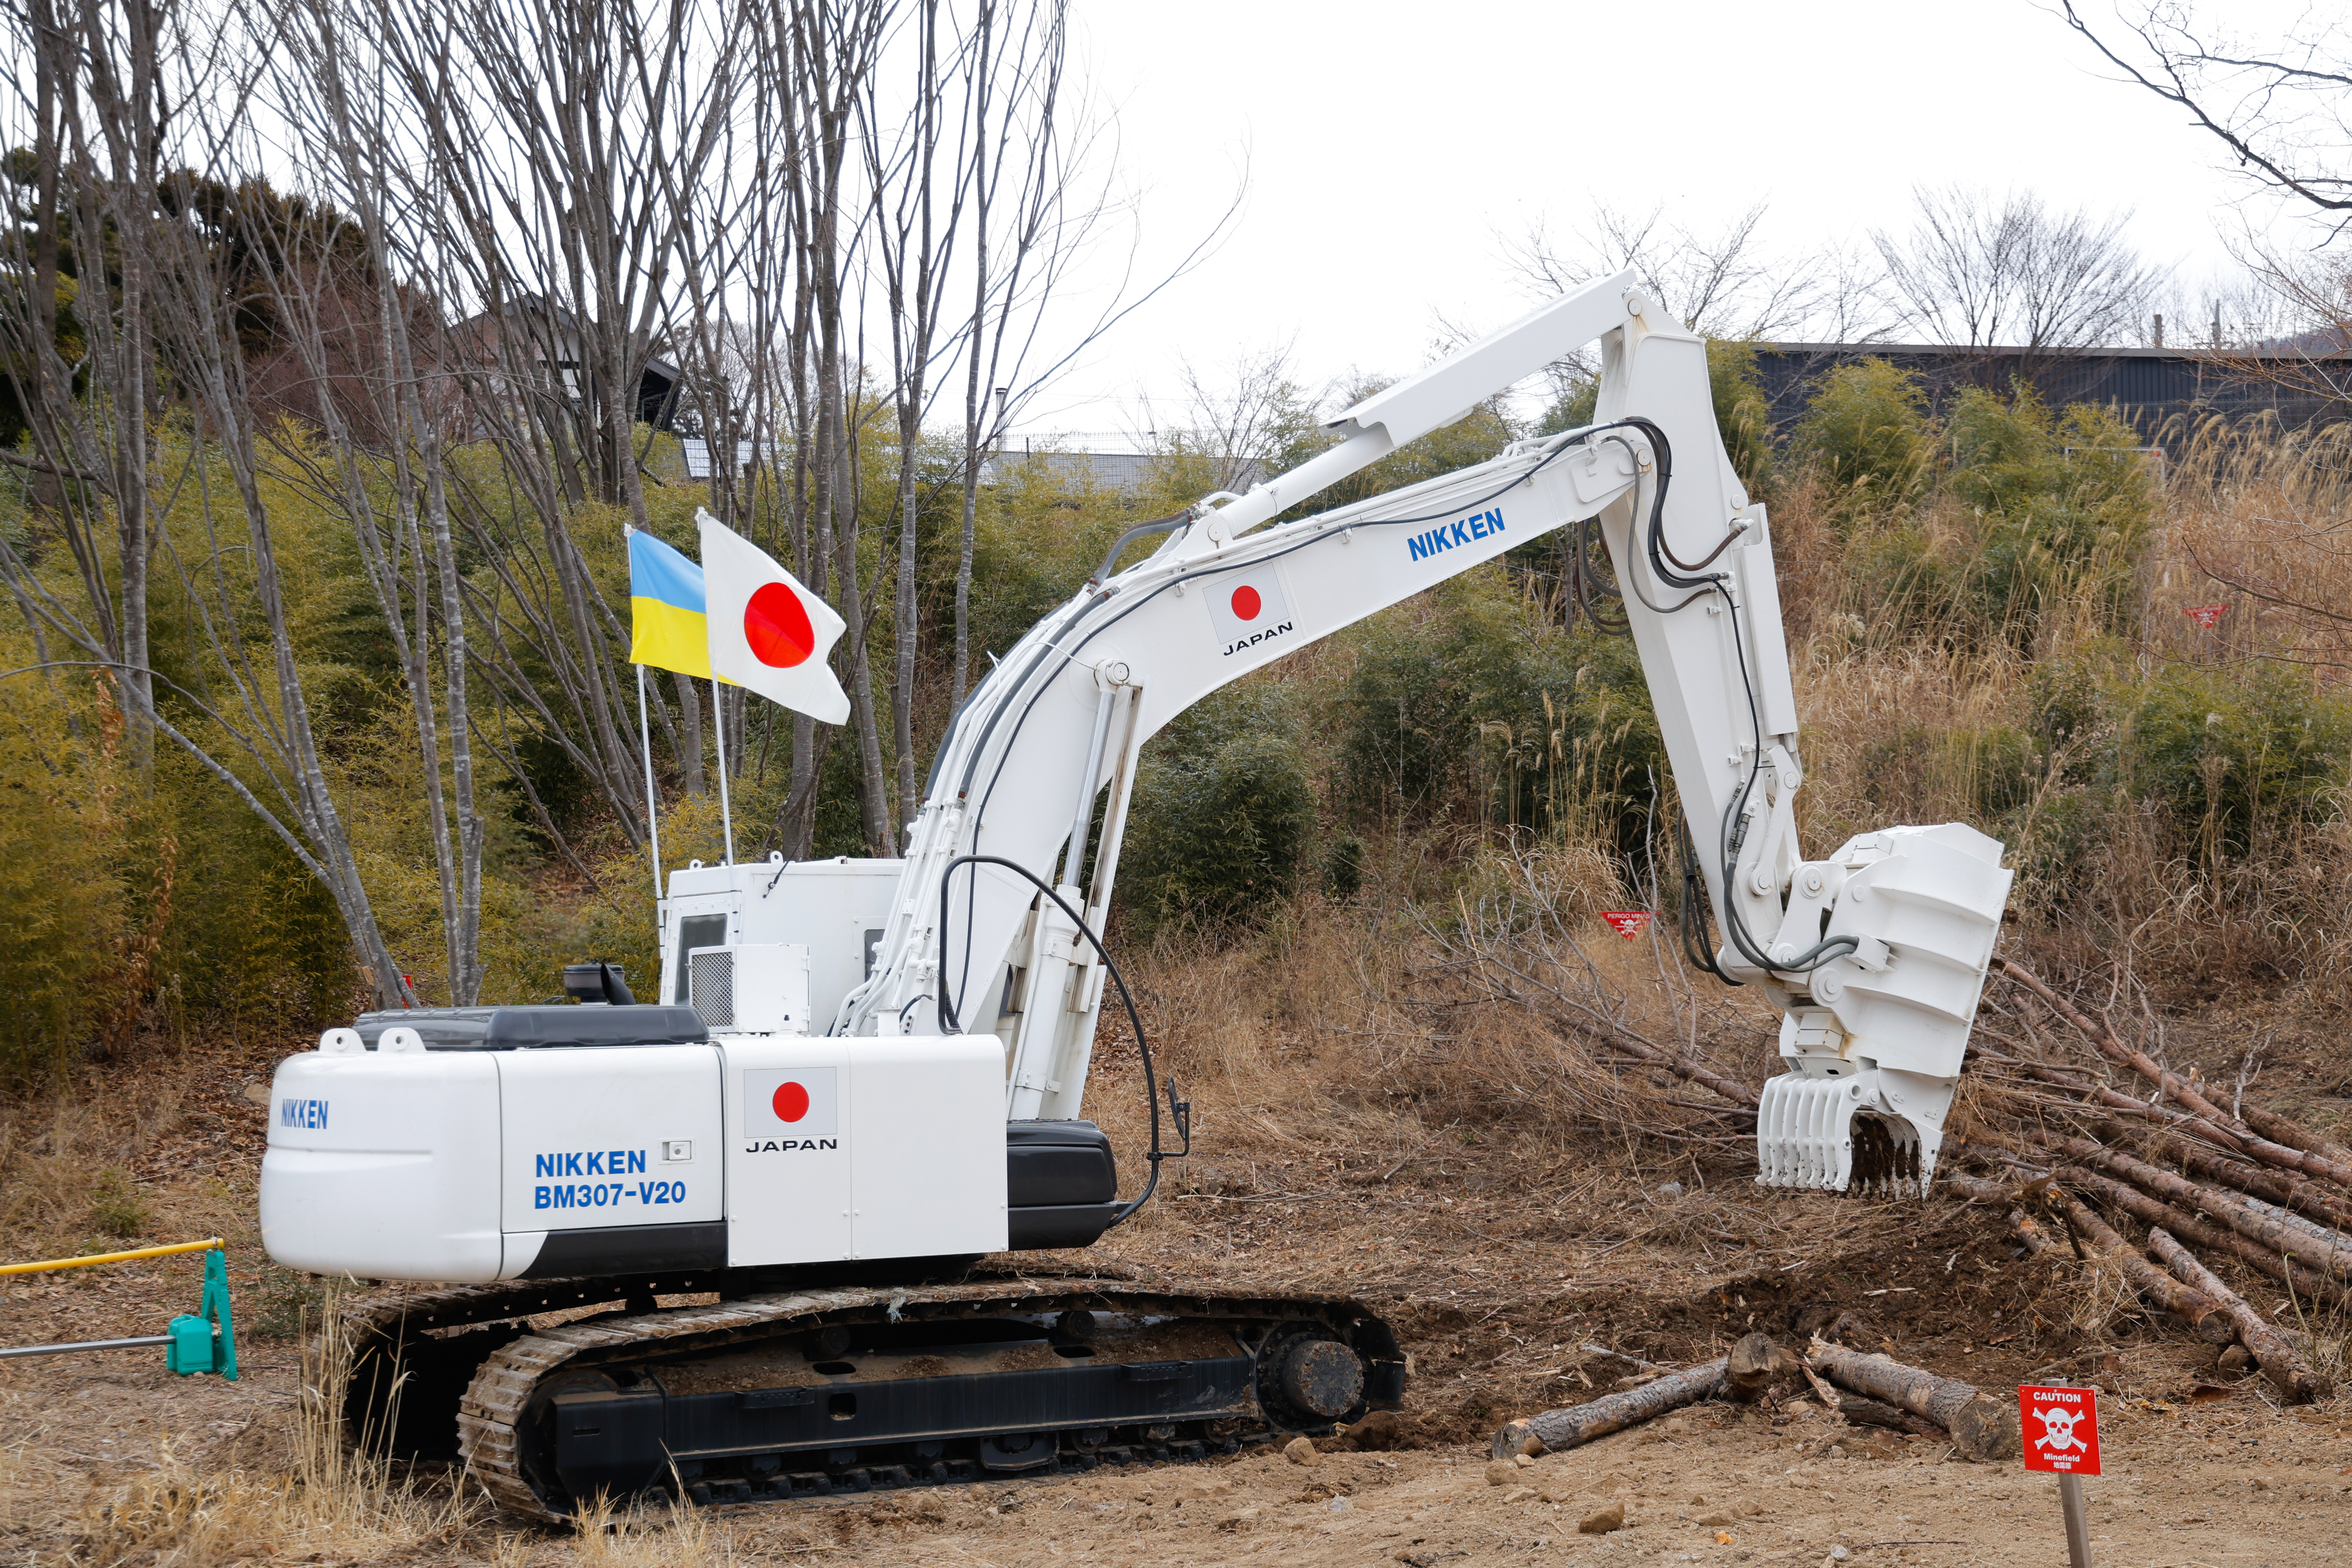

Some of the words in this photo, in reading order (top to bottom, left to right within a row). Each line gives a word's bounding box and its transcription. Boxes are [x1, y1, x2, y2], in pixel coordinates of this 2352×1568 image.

[1407, 508, 1505, 561] NIKKEN
[1224, 621, 1293, 656] JAPAN
[282, 1099, 328, 1129] NIKKEN
[746, 1139, 838, 1153] JAPAN
[536, 1149, 646, 1178] NIKKEN
[535, 1181, 686, 1210] BM307-V20
[2033, 1392, 2081, 1403] CAUTION
[2043, 1453, 2080, 1462] Minefield
